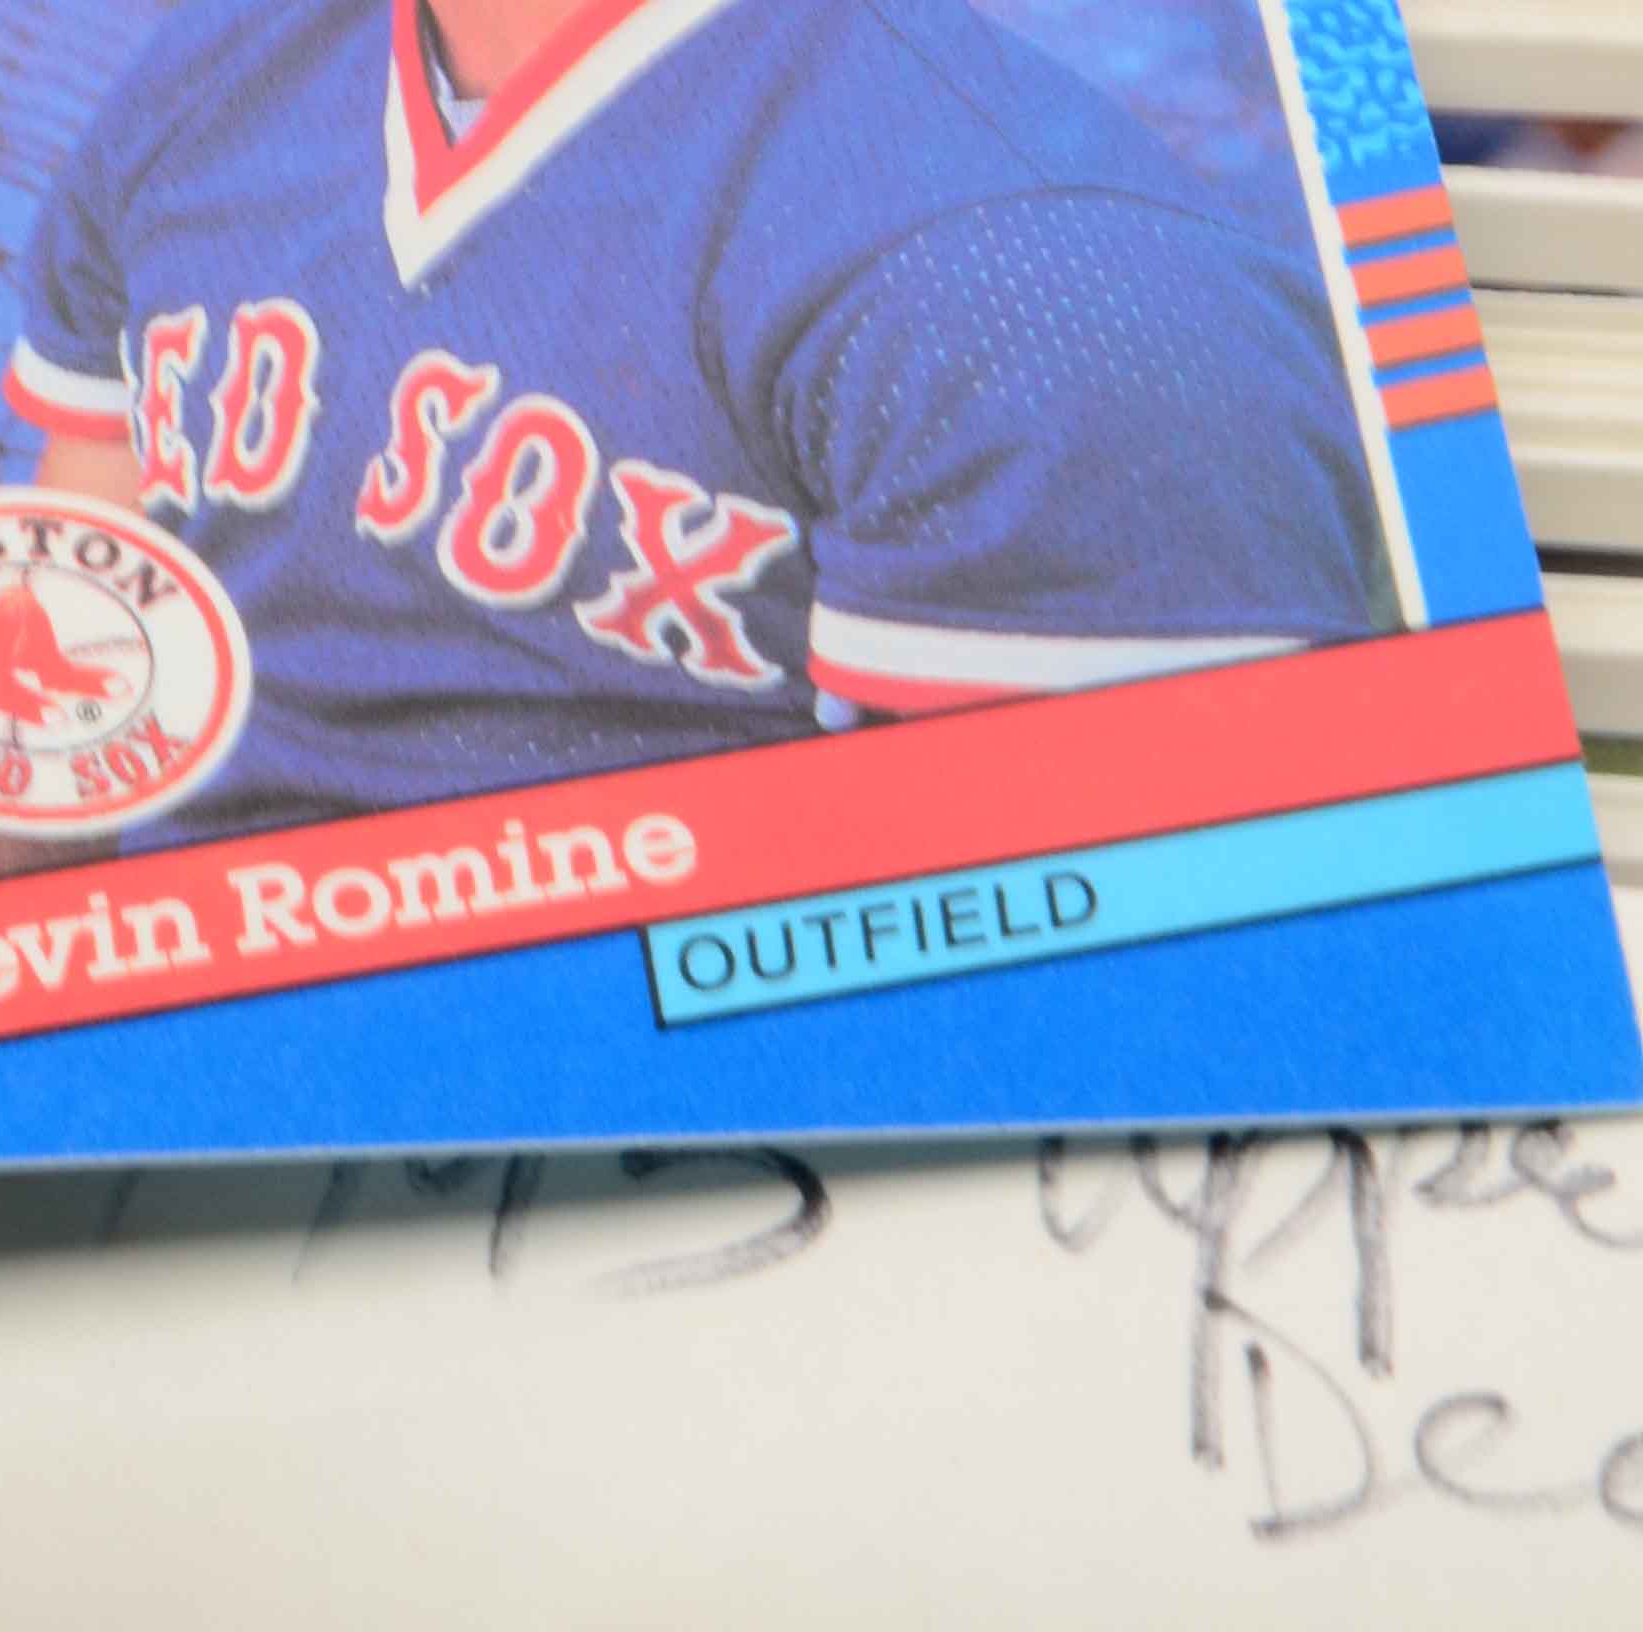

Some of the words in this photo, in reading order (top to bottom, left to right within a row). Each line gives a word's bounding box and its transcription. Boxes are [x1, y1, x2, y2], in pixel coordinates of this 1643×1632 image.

[119, 298, 323, 518] ED
[357, 349, 798, 692] SOX
[68, 710, 193, 800] SOX
[227, 810, 699, 956] Romine
[677, 868, 1099, 996] OUTFIELD
